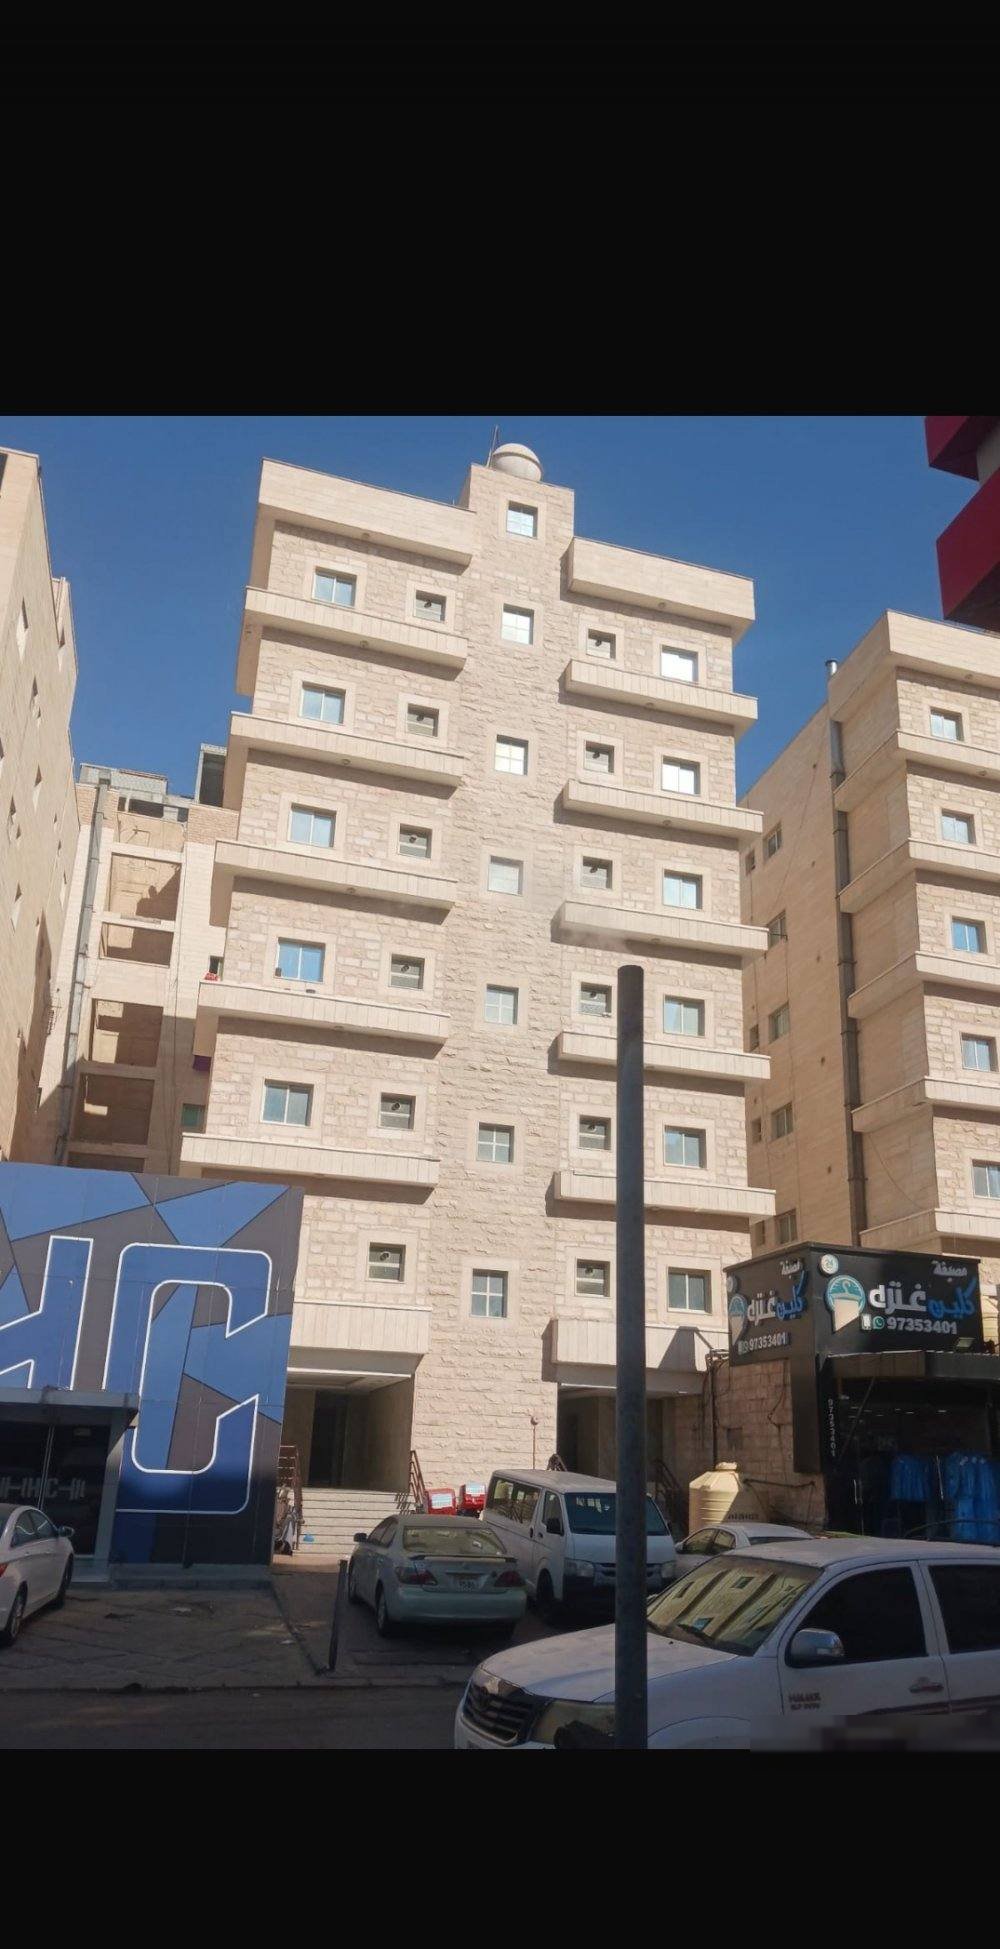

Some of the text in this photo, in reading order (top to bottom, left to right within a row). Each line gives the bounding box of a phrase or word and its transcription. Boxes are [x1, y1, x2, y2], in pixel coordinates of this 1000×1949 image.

[931, 1260, 967, 1282] مصبغة
[886, 1316, 958, 1335] 97353401
[749, 1331, 787, 1351] 97353401
